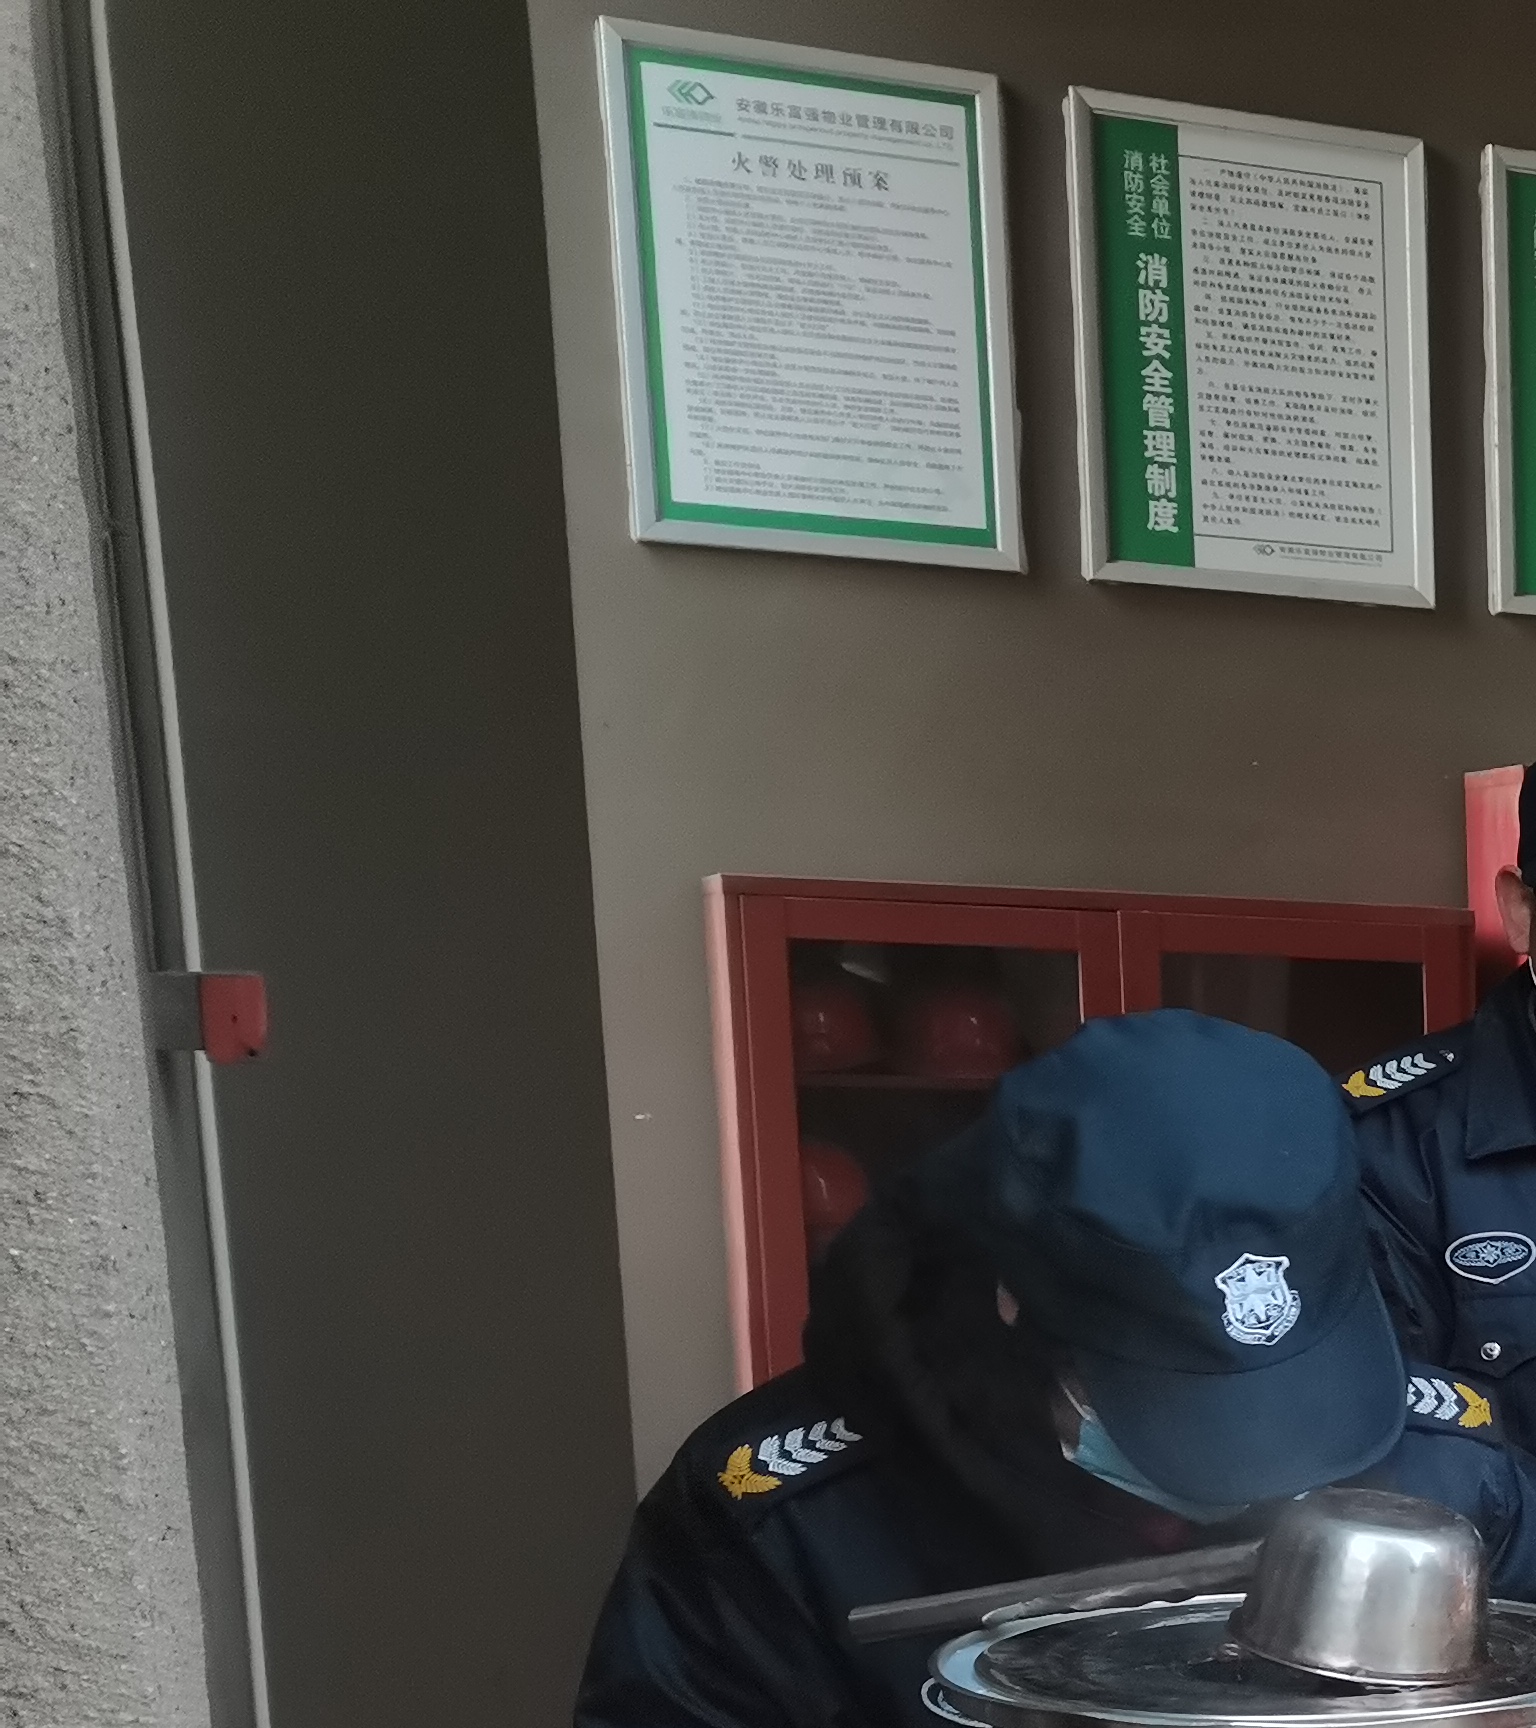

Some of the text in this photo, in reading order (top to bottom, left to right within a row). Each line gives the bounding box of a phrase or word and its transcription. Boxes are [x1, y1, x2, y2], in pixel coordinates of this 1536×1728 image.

[731, 151, 890, 192] 火警处理预案
[1122, 148, 1147, 238] 消防安全
[1150, 152, 1173, 240] 社会单位
[1135, 252, 1180, 534] 消防安全管理制度
